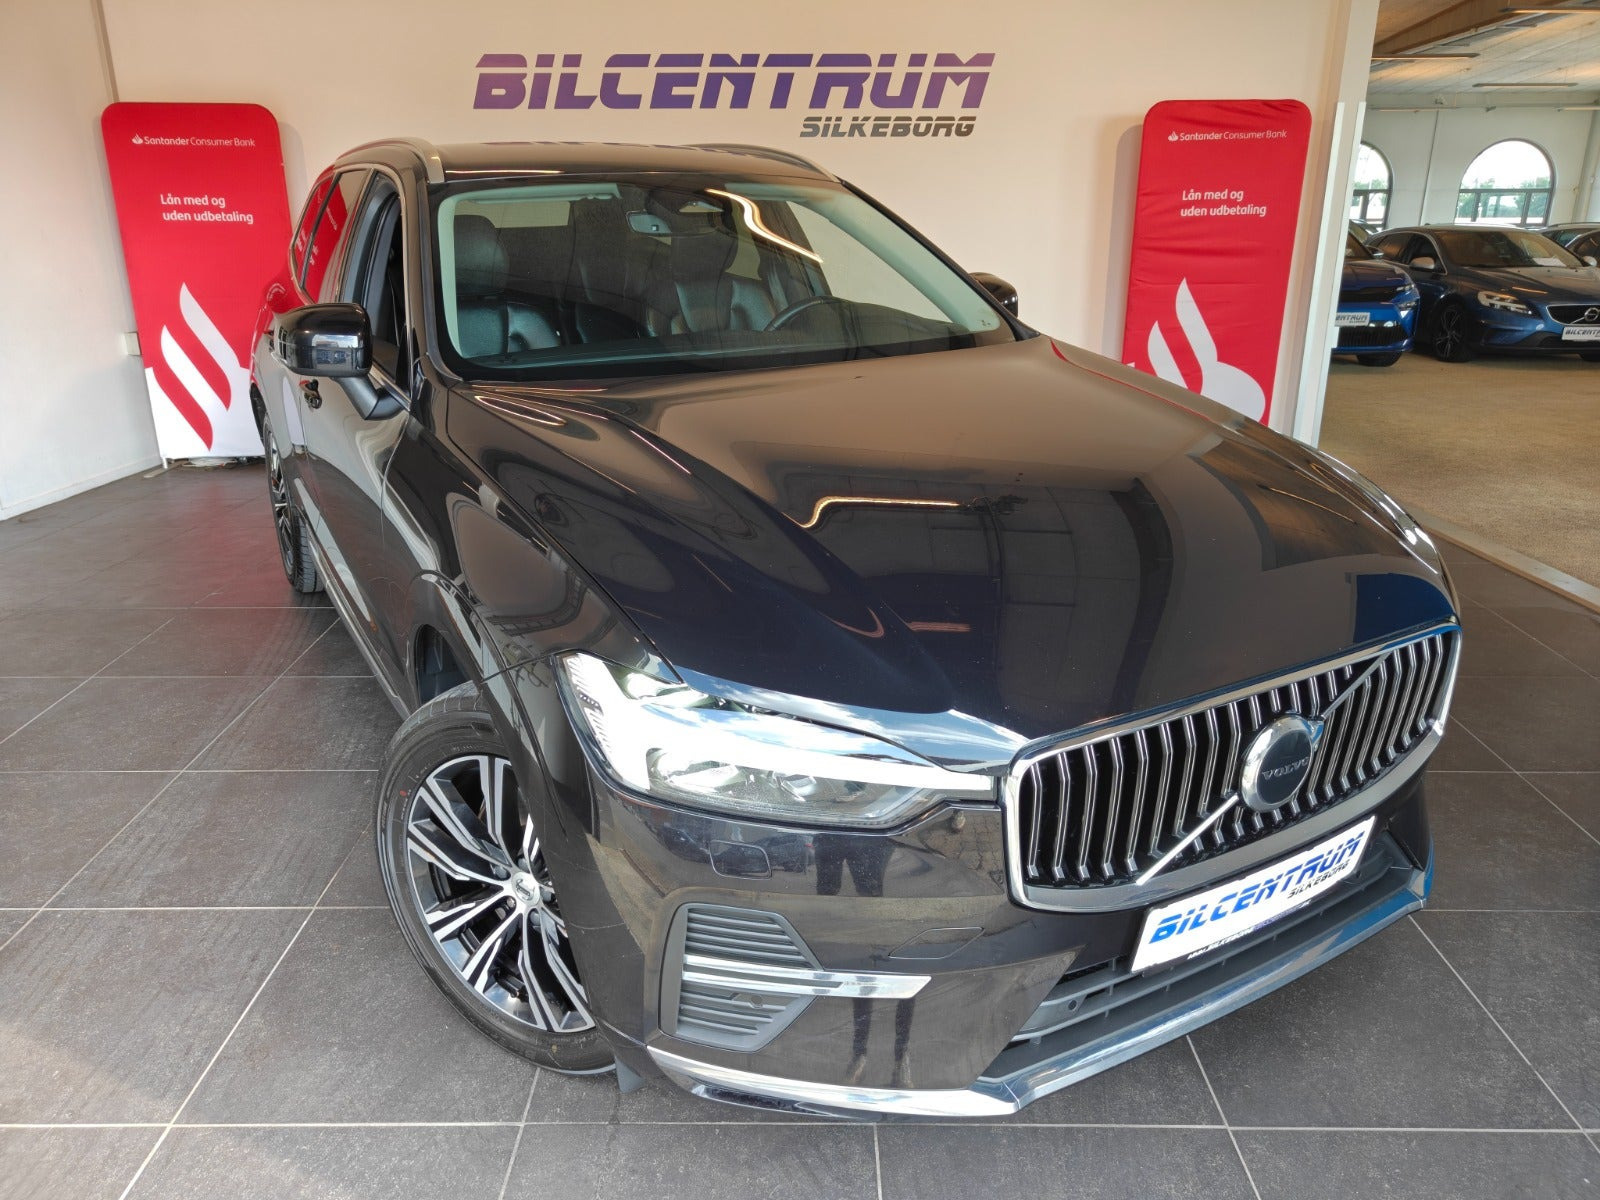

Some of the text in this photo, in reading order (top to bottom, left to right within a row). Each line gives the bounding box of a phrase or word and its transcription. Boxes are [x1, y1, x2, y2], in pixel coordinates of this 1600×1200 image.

[473, 53, 996, 109] BILCENTRUM
[799, 116, 976, 138] SILKEBORG
[144, 136, 255, 147] Santander Consumer Bank
[1180, 130, 1287, 141] Santander Consumer Bank
[160, 193, 226, 208] Lån med og
[1182, 189, 1244, 202] Lån med og
[163, 210, 254, 224] uden udbetaling
[1181, 204, 1267, 217] uden udbetaling
[1262, 756, 1310, 780] VOLVO
[1287, 859, 1350, 899] SILKEBORG
[1149, 831, 1365, 945] BILCENTRUM
